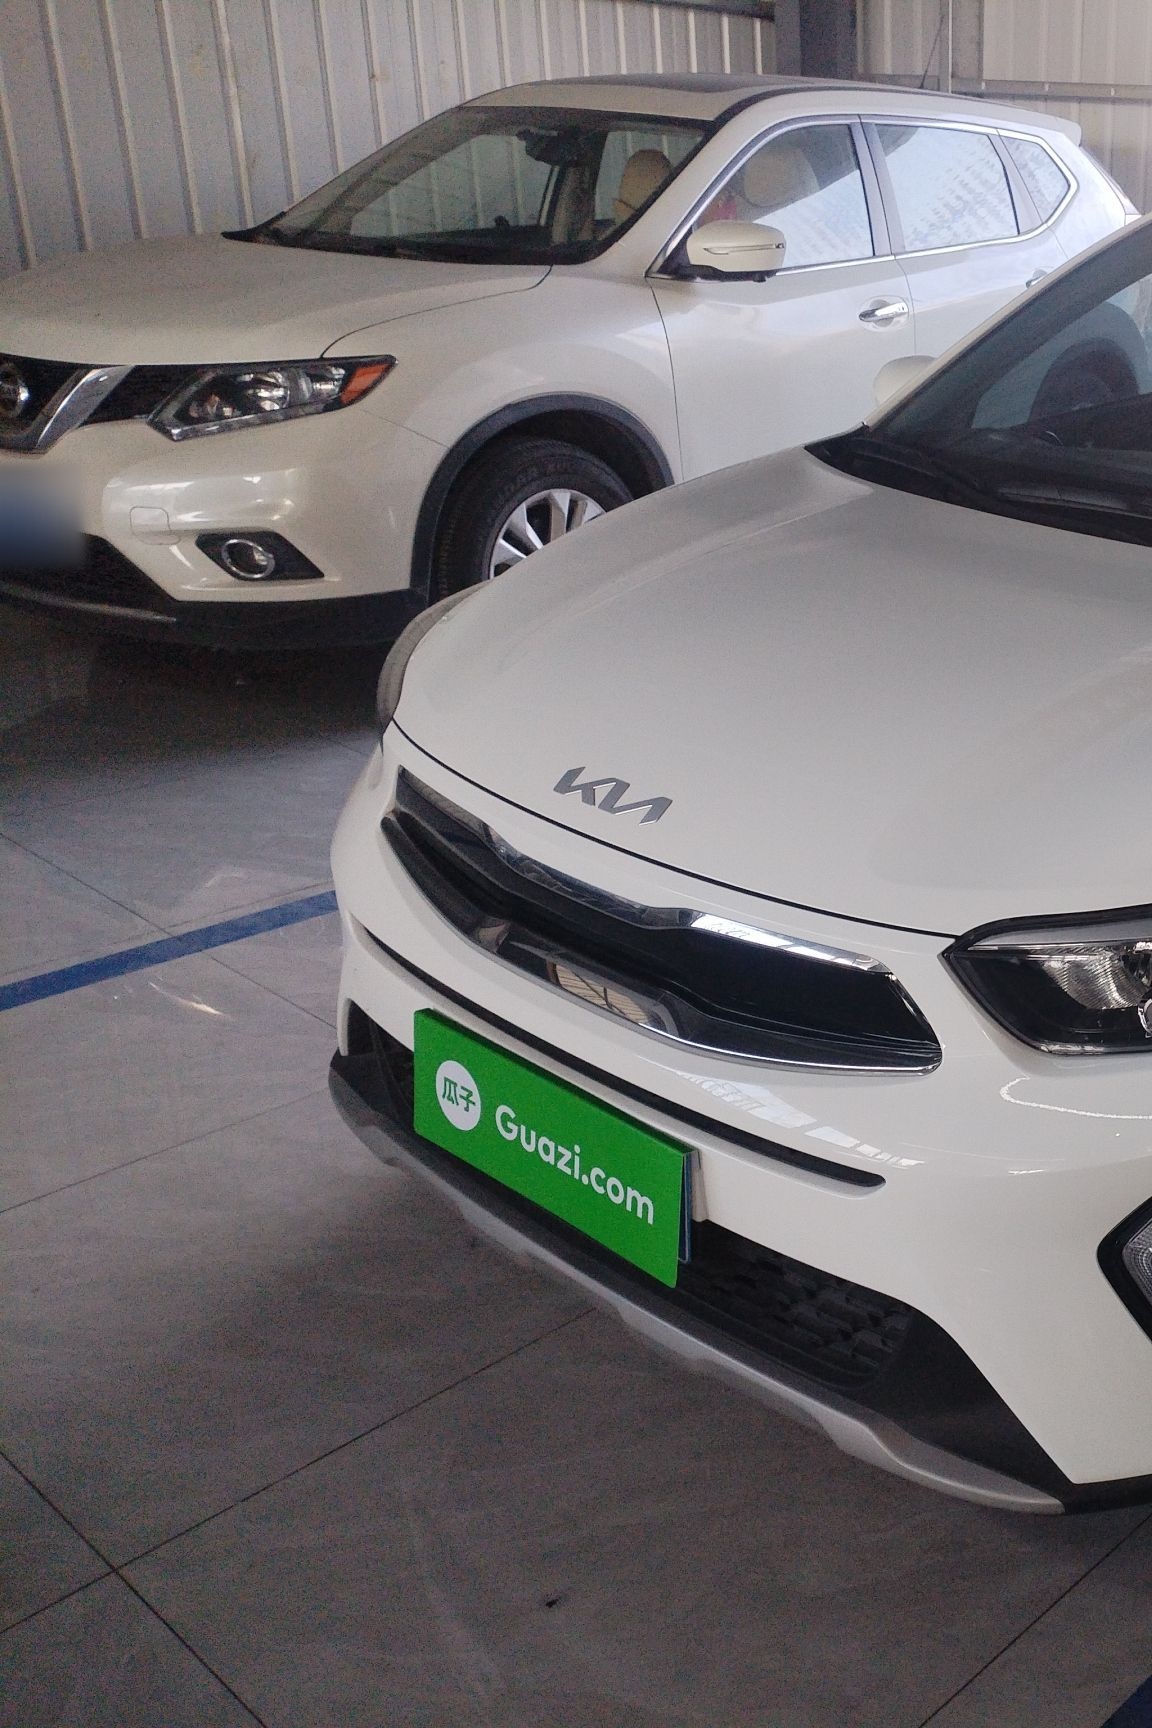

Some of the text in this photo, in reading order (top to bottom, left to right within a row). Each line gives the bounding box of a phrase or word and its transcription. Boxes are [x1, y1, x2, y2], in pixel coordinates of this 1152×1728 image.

[553, 767, 673, 826] KIA
[442, 1076, 476, 1112] 瓜子
[495, 1105, 654, 1225] Guazi.com
